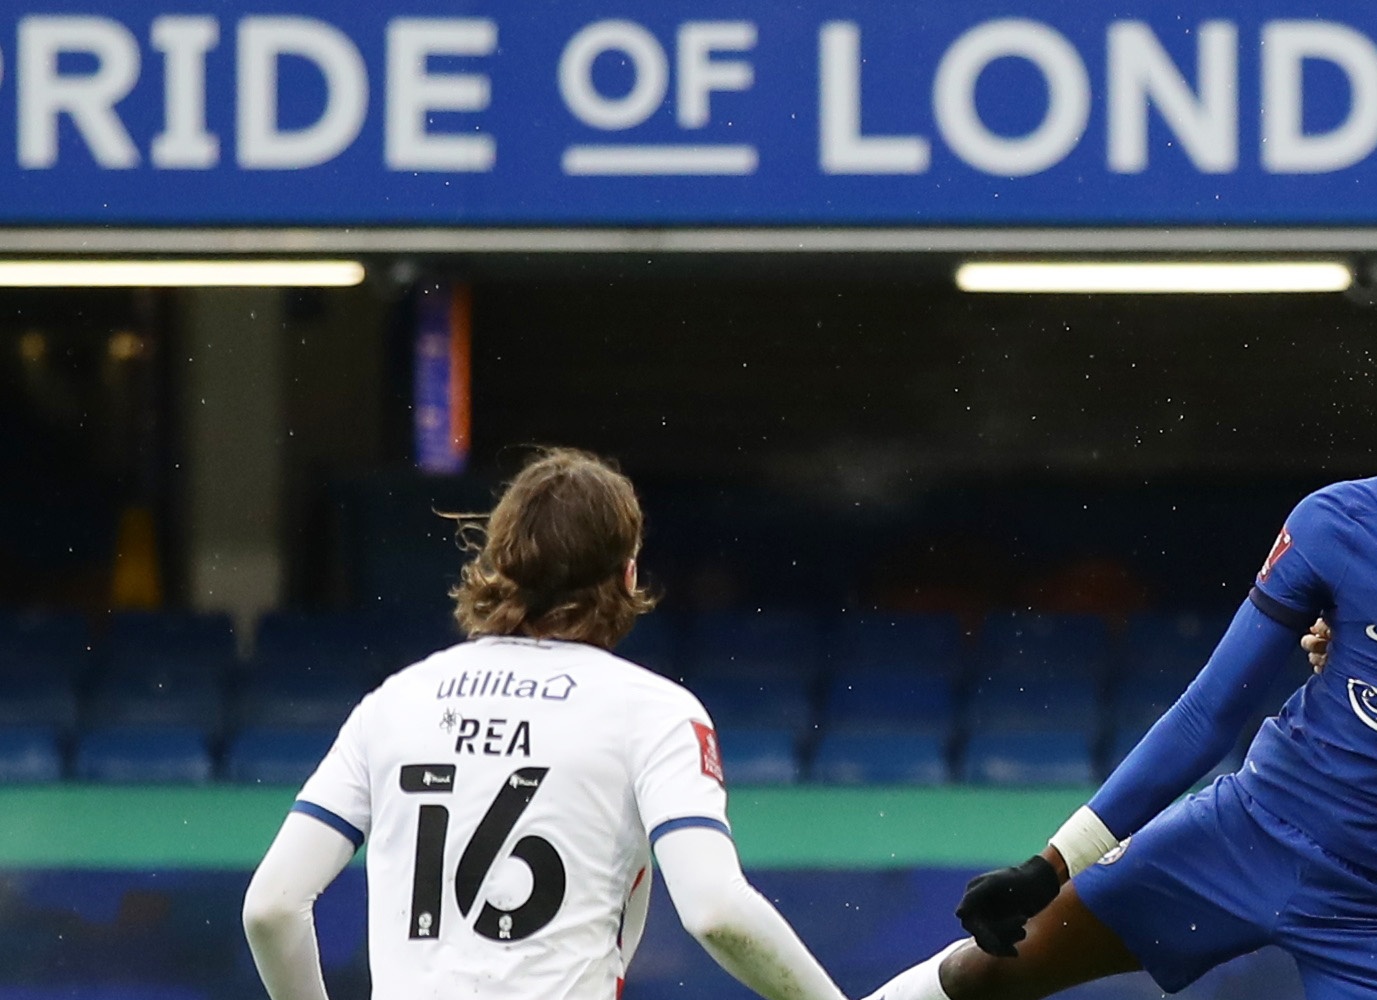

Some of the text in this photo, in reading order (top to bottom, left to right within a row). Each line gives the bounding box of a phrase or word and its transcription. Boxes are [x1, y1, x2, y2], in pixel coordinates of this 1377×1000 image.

[0, 16, 497, 170] RIDE
[557, 19, 759, 129] OF
[437, 671, 538, 700] utilita
[455, 718, 531, 757] REA
[399, 763, 567, 944] 16
